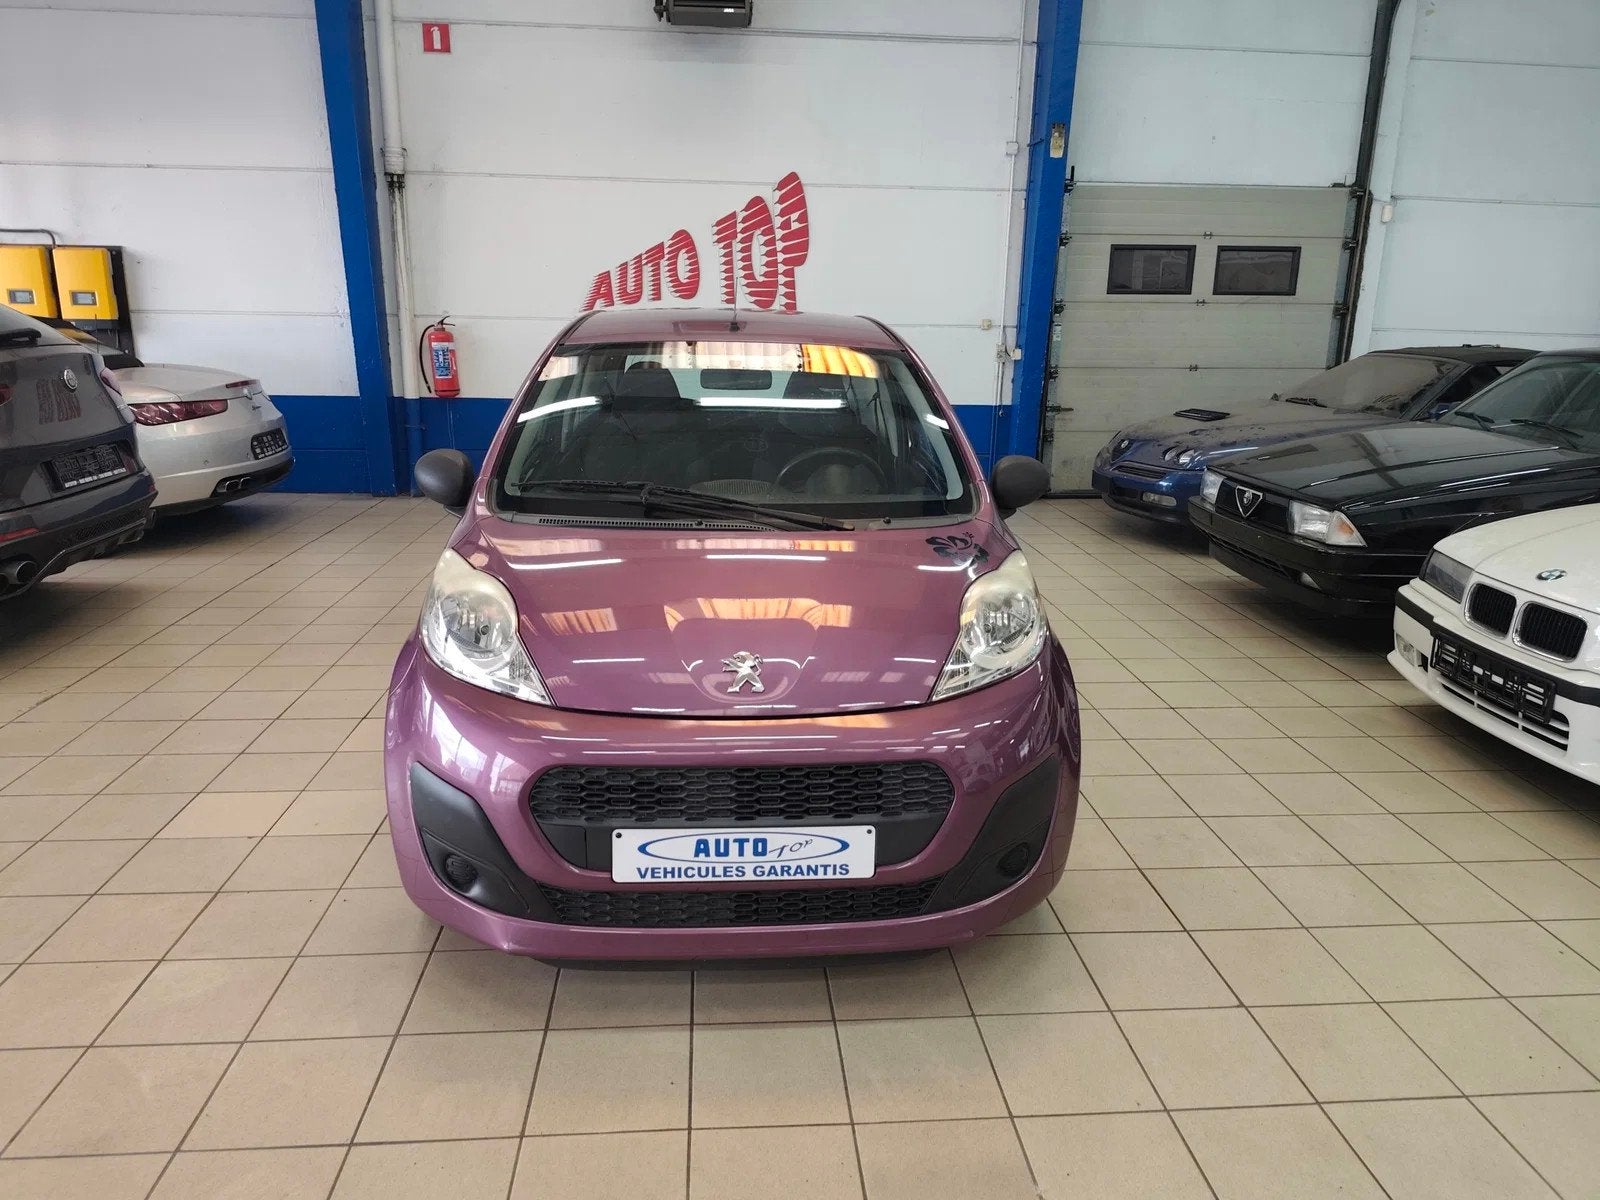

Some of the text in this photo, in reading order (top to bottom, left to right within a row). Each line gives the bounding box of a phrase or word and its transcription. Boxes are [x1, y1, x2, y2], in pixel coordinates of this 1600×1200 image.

[580, 171, 809, 312] AUTO TOP
[693, 837, 769, 858] AUTO
[636, 863, 850, 879] VEHICULES GARANTIS
